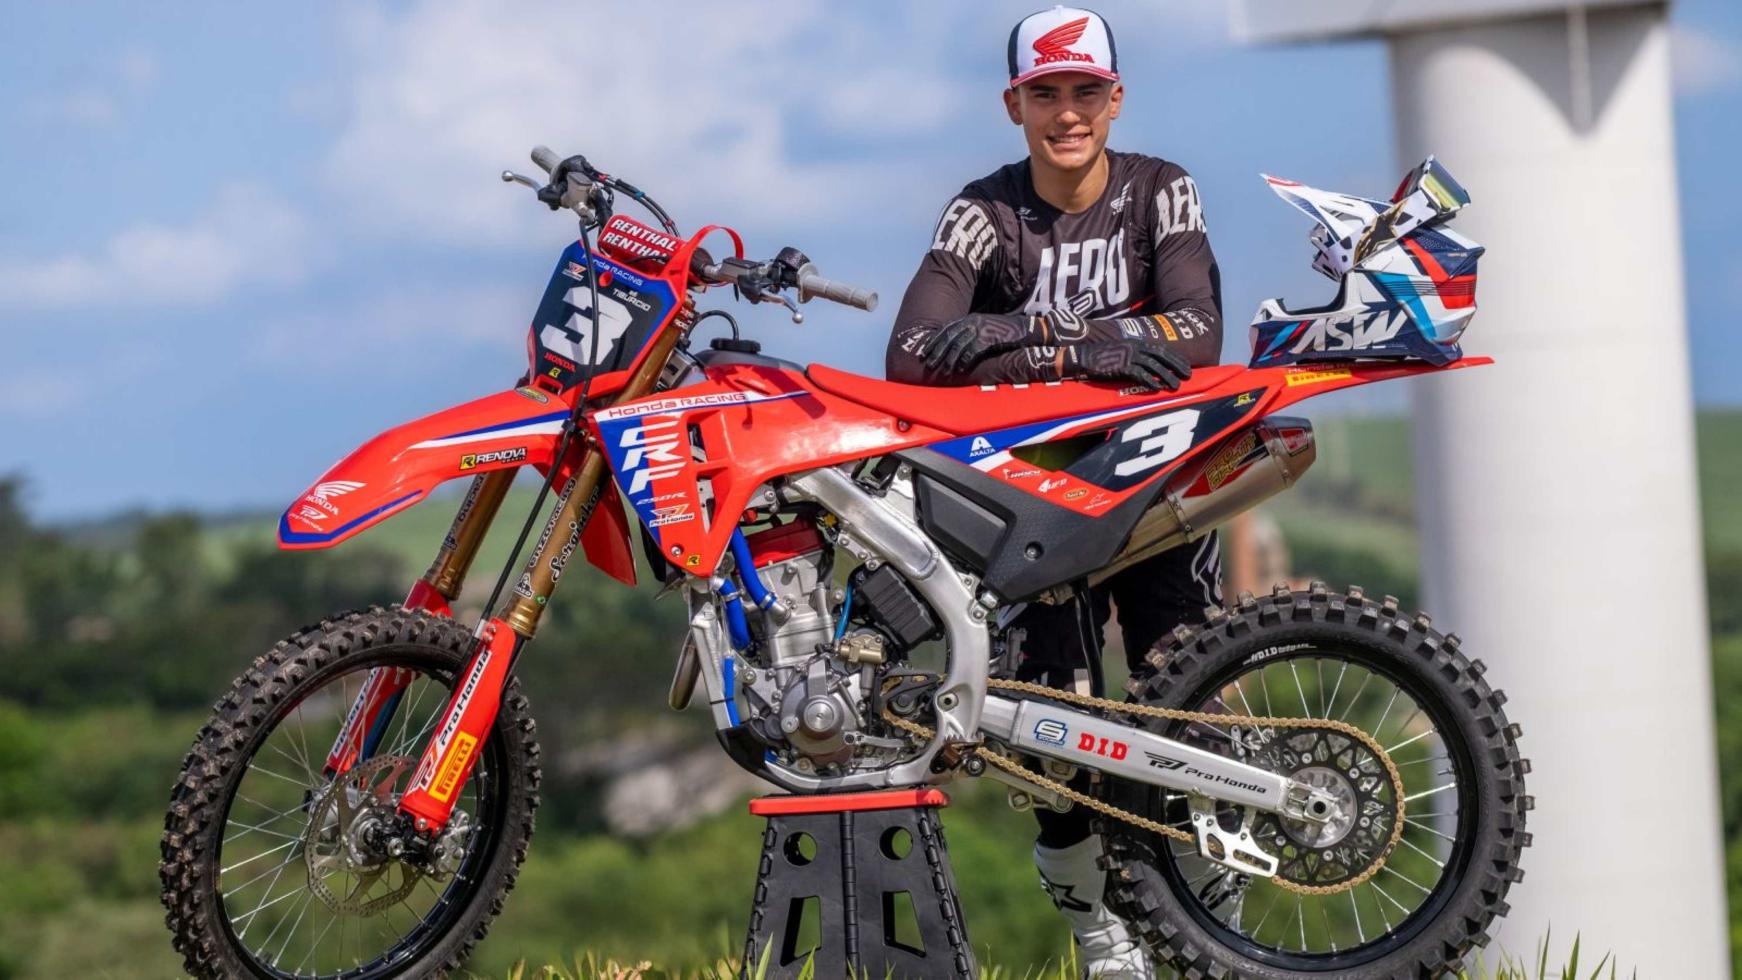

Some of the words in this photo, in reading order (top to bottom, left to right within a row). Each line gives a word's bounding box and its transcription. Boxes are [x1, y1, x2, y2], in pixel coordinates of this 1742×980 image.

[1034, 53, 1095, 67] HONDA
[1155, 175, 1207, 250] AER
[611, 218, 677, 252] RENTHAL
[1024, 228, 1130, 317] AERO
[539, 286, 633, 366] 3
[544, 351, 577, 373] HONDA
[608, 400, 677, 419] Honda
[680, 392, 746, 408] RACING
[475, 447, 527, 464] RENOVA
[619, 420, 688, 496] CRF
[969, 447, 997, 458] AXALTA
[1114, 408, 1200, 477] 3
[306, 494, 340, 517] HONDA
[439, 650, 490, 746] ProHonda
[1077, 732, 1129, 761] D.I.D
[436, 738, 473, 797] PIRELLI
